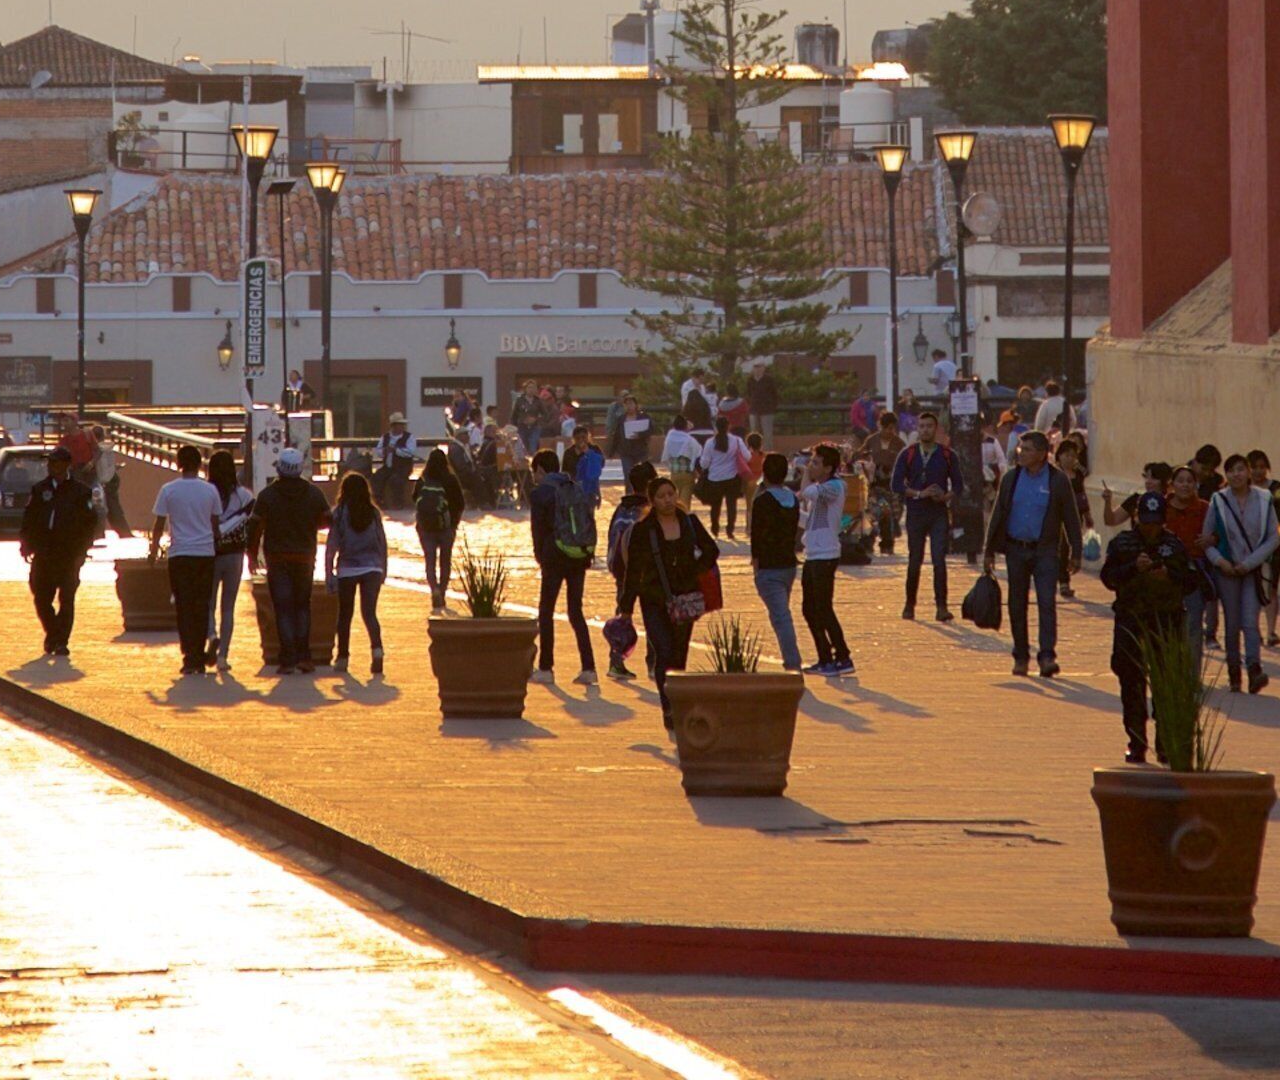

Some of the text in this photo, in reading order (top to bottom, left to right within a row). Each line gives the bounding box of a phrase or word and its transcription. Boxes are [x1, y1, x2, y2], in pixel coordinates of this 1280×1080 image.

[248, 266, 264, 364] EMERGENCIAS
[499, 334, 650, 353] BBVA Bancomer
